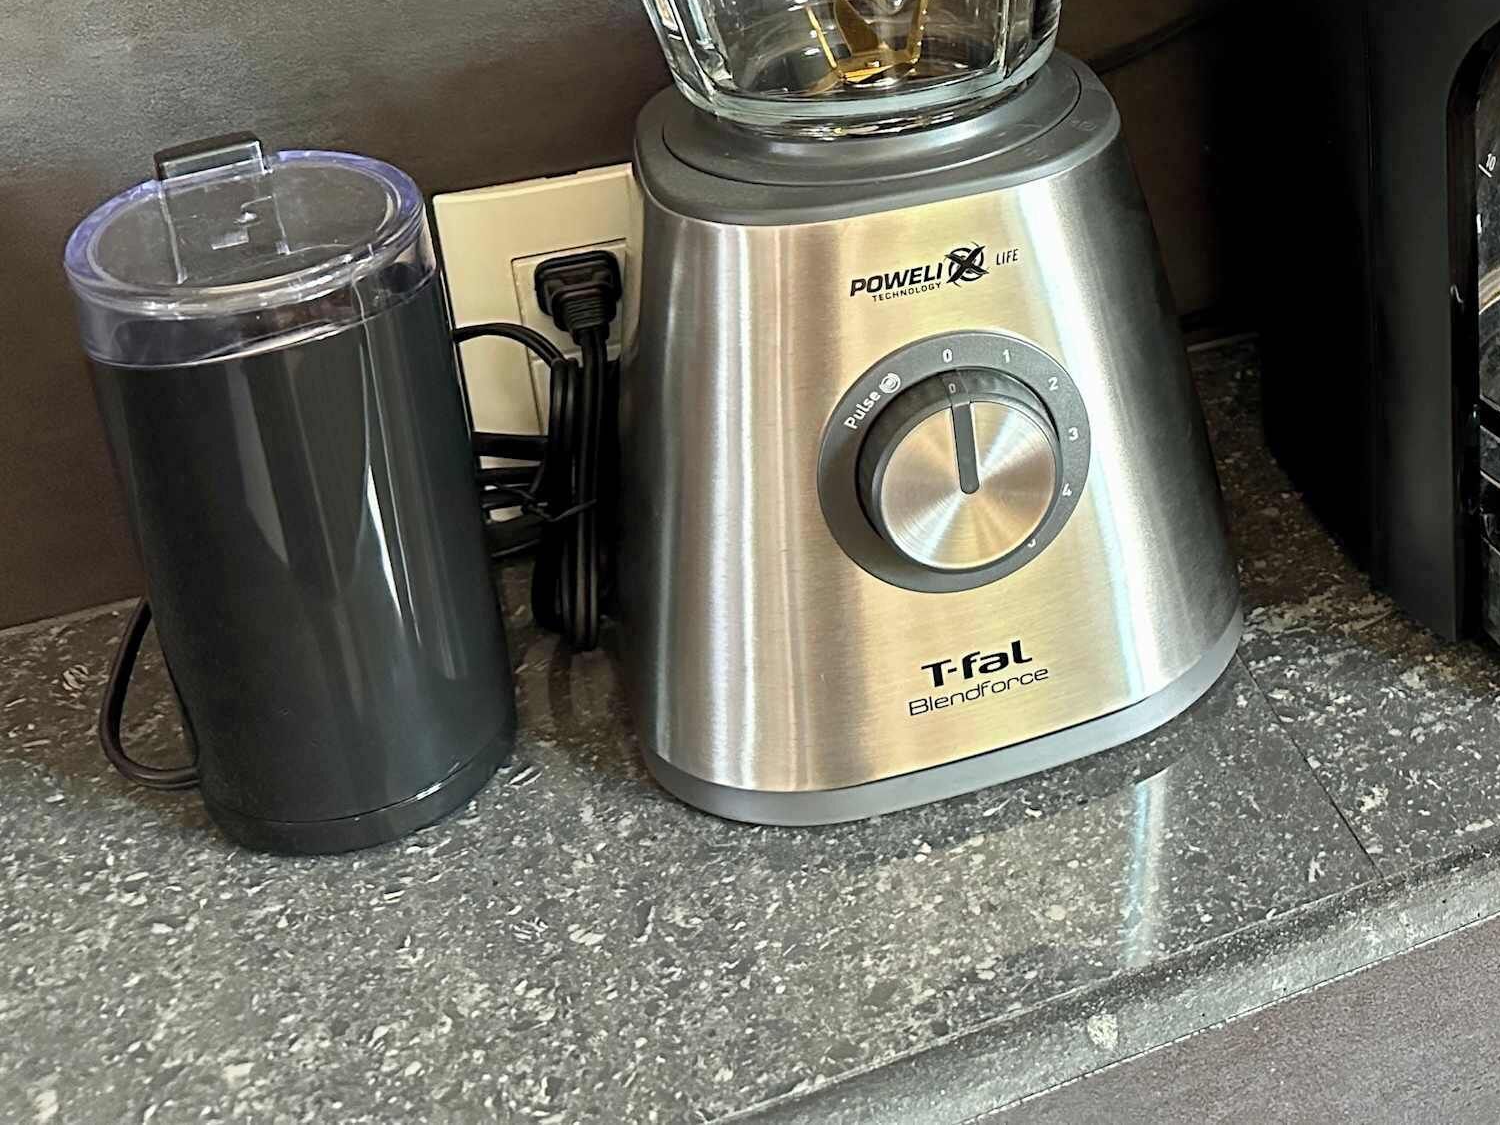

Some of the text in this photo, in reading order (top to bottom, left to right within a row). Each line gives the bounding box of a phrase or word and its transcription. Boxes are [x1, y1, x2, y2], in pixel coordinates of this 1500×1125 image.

[1485, 153, 1497, 172] 10
[996, 248, 1019, 266] LIFE
[872, 281, 943, 302] TECHNOLOGY
[942, 348, 953, 363] 0
[1002, 349, 1011, 363] 1
[1048, 376, 1059, 391] 2
[844, 391, 881, 430] Pulse
[1068, 427, 1079, 441] 3
[1061, 483, 1073, 497] 4
[921, 640, 1033, 688] T-fal
